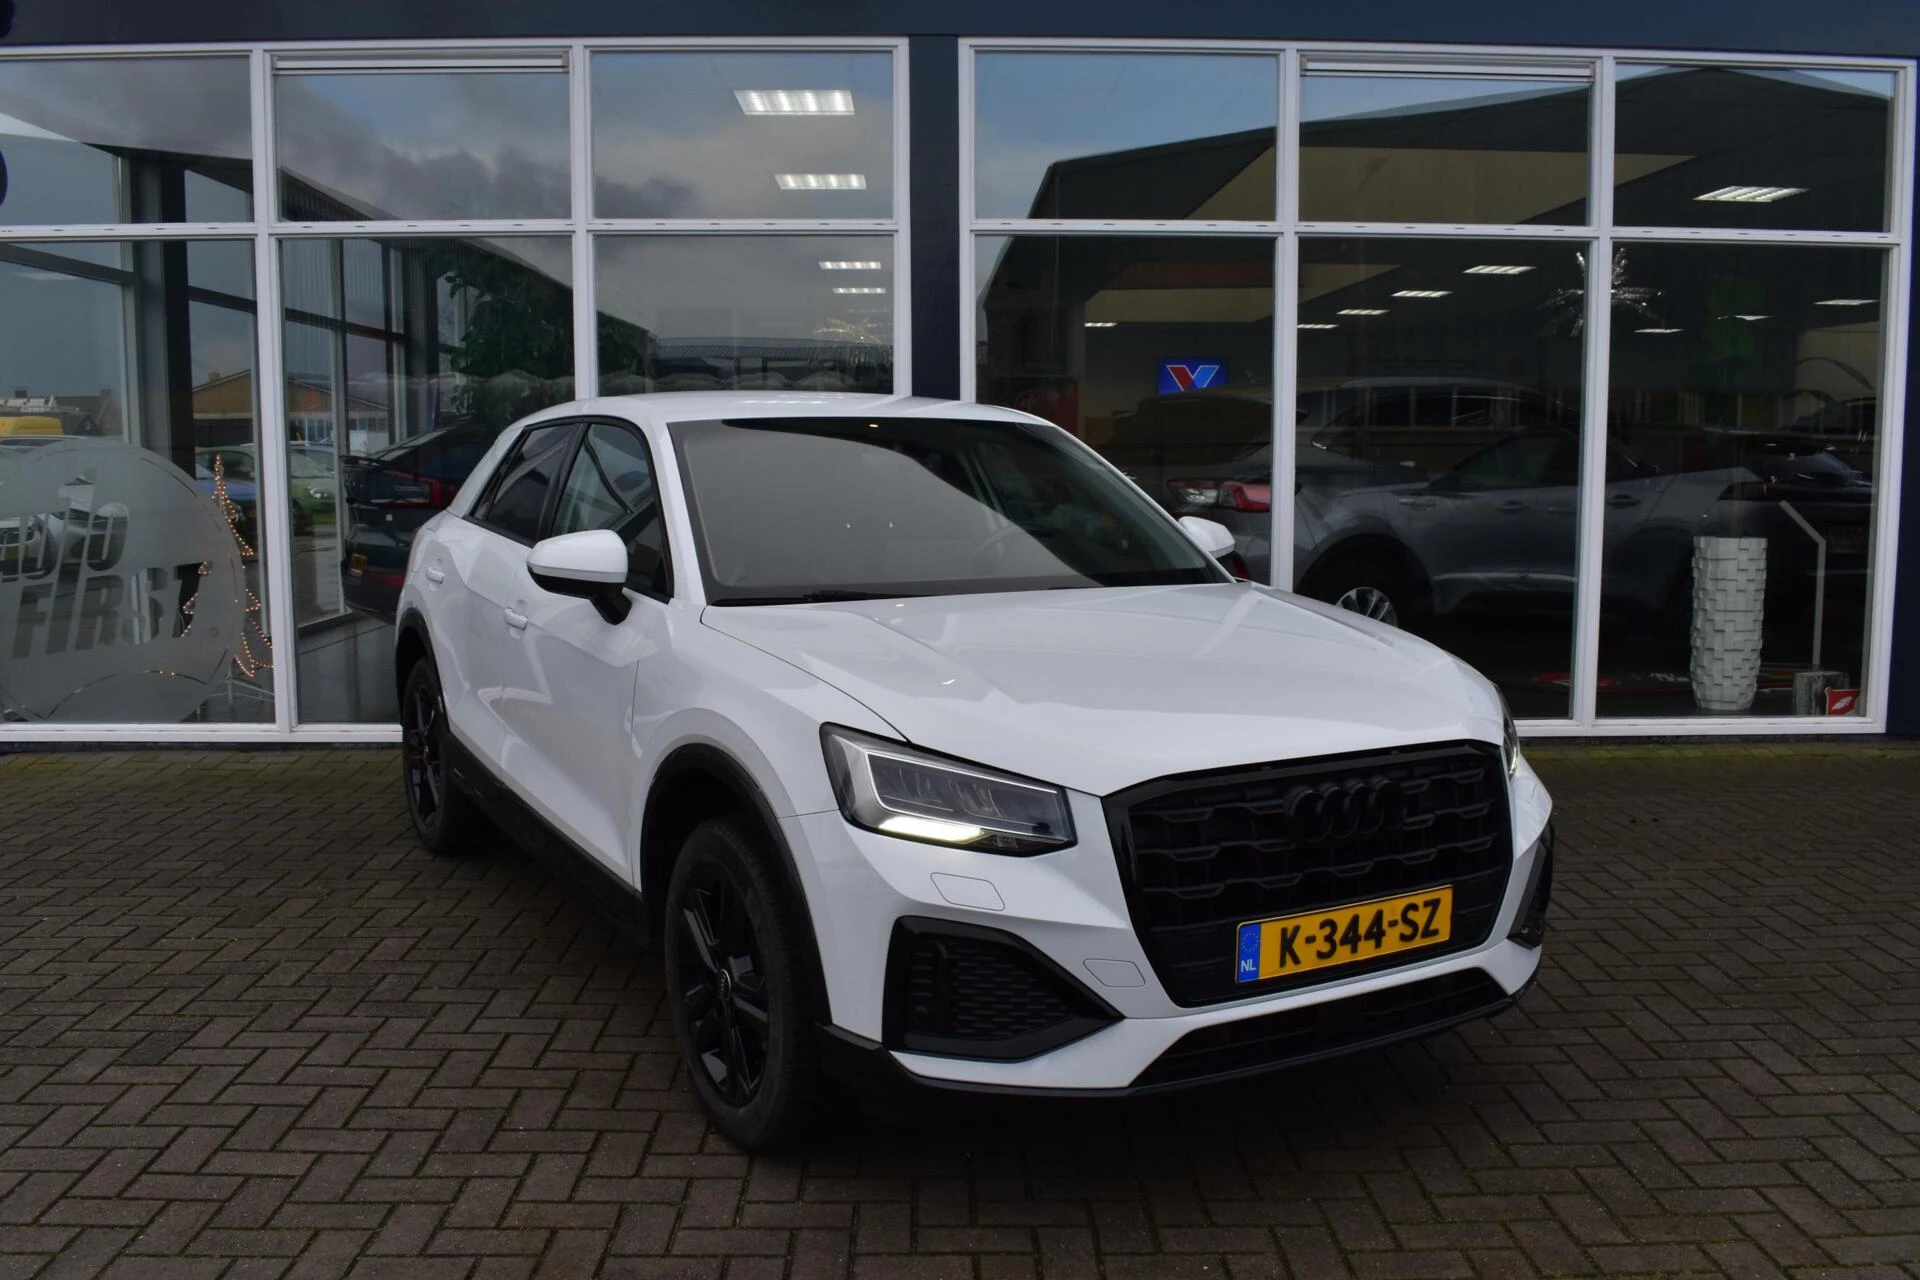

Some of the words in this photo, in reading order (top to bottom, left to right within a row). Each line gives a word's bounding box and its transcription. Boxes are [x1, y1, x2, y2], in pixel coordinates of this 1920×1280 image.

[12, 560, 212, 658] FIRST
[1240, 958, 1257, 972] NL
[1279, 897, 1442, 968] K-344-SZ
